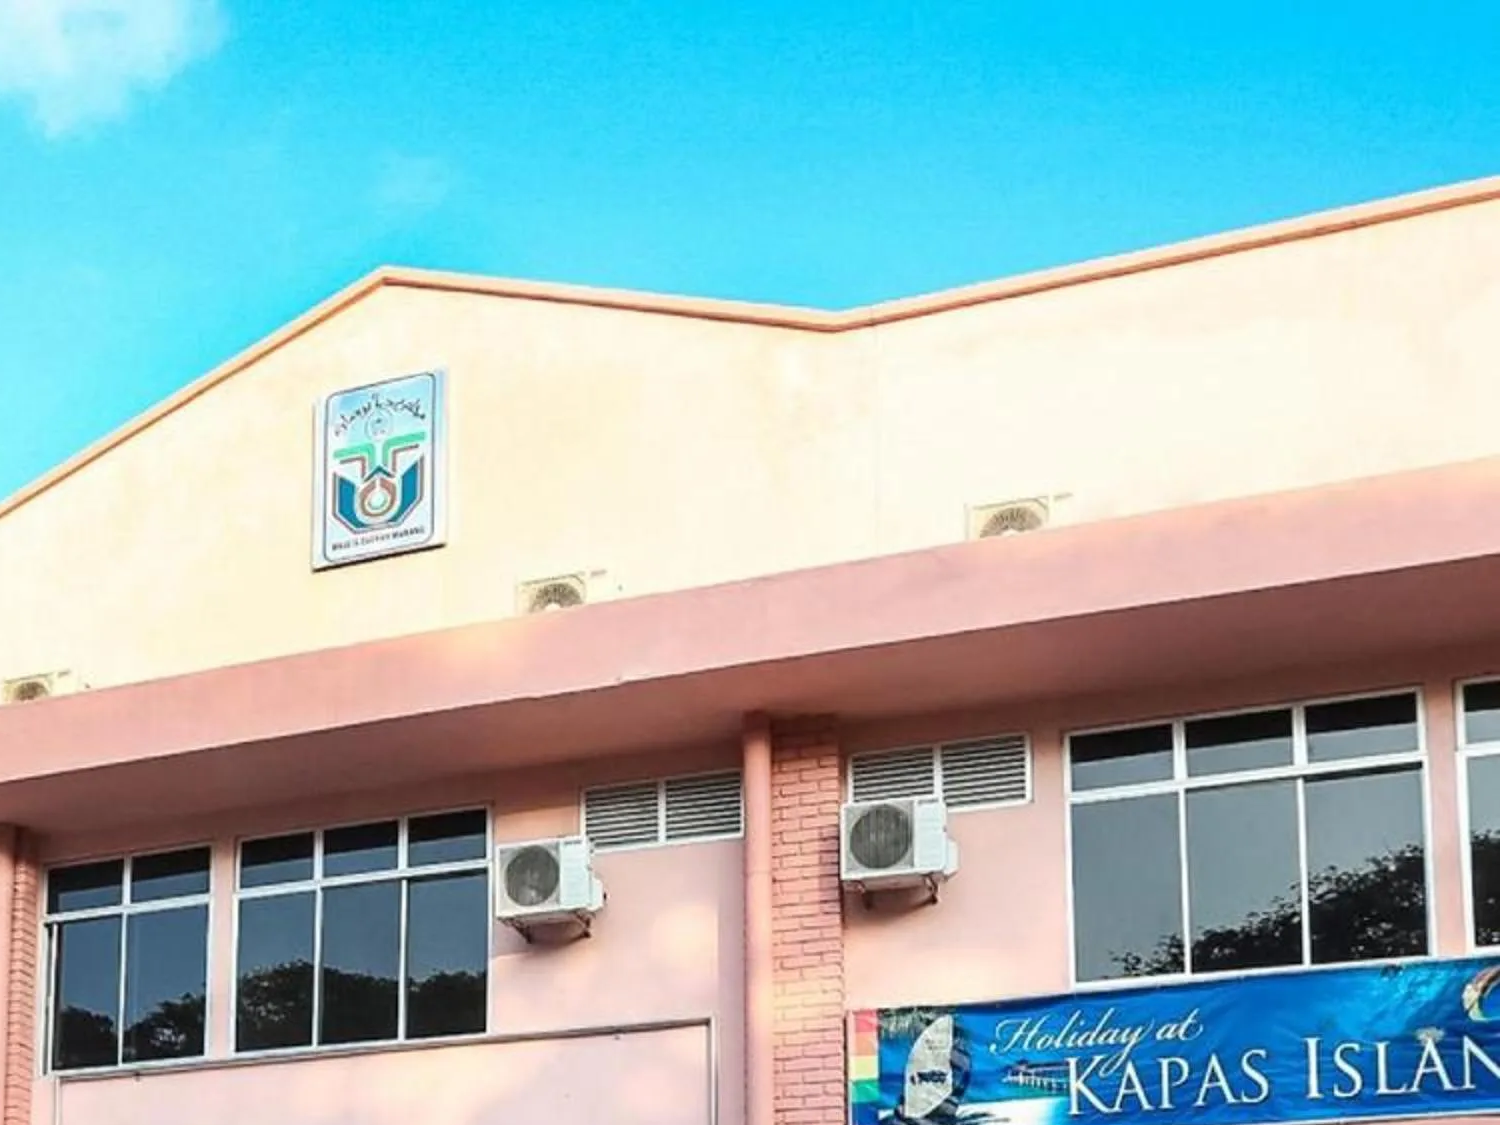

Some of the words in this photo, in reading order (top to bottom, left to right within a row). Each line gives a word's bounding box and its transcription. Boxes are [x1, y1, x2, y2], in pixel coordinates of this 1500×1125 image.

[989, 1007, 1154, 1077] Holiday
[1155, 1007, 1203, 1041] at
[1065, 1049, 1270, 1115] KAPAS
[1304, 1034, 1500, 1099] ISLAN
